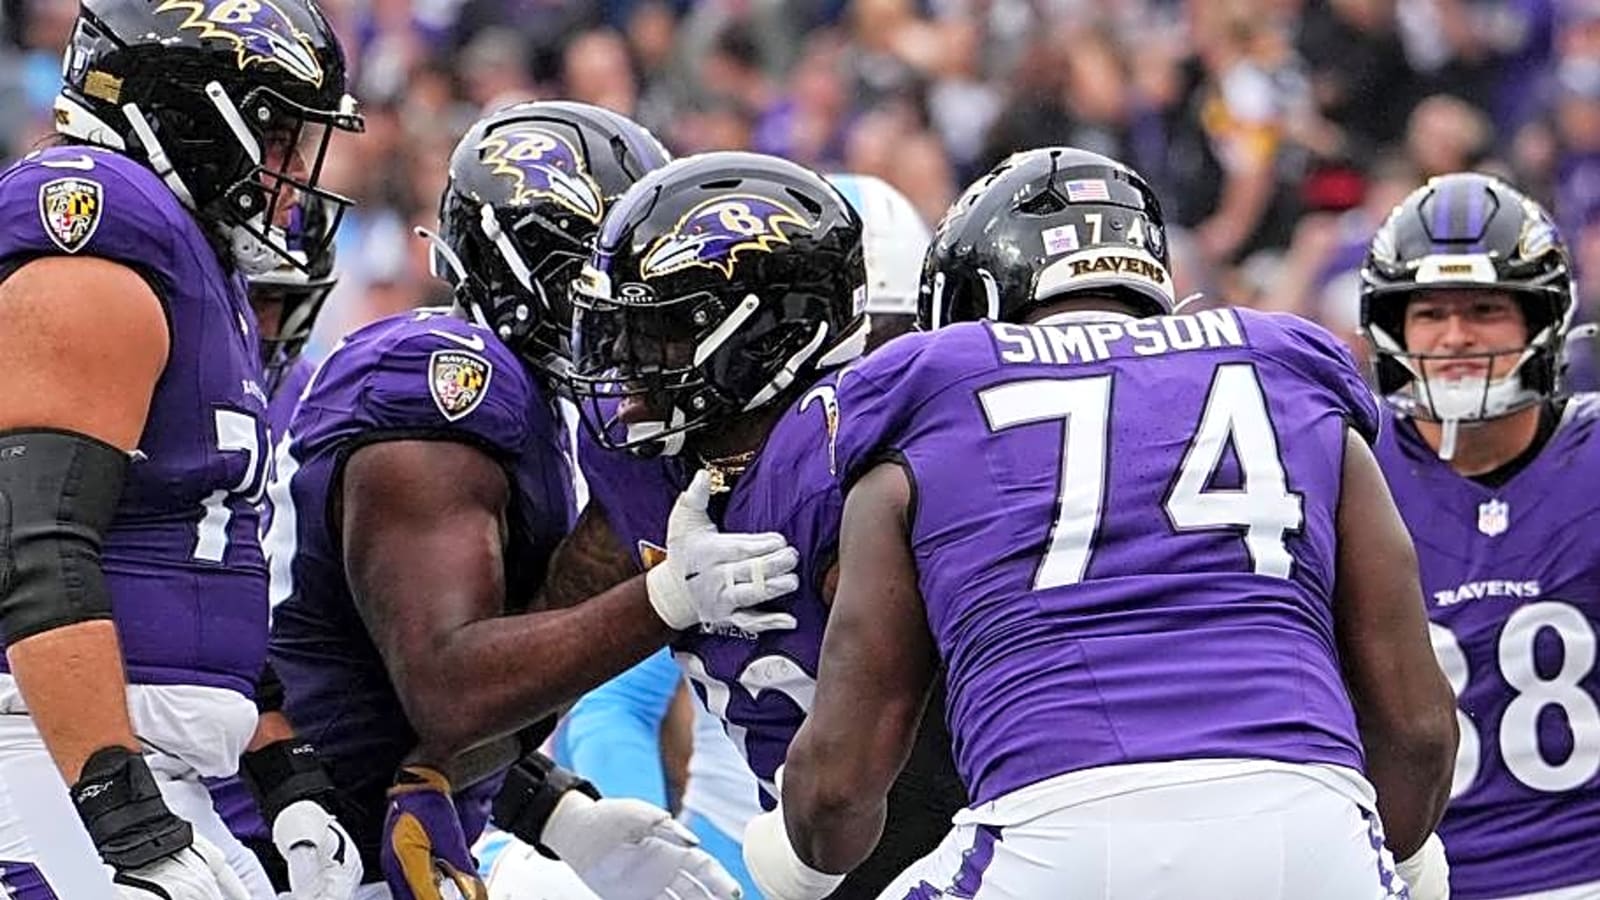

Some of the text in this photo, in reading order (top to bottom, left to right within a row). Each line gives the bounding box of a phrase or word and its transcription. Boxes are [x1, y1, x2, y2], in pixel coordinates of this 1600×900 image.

[1069, 256, 1165, 284] RAVENS
[991, 308, 1244, 365] SIMPSON
[976, 361, 1306, 592] 74
[1434, 580, 1541, 606] RAVENS
